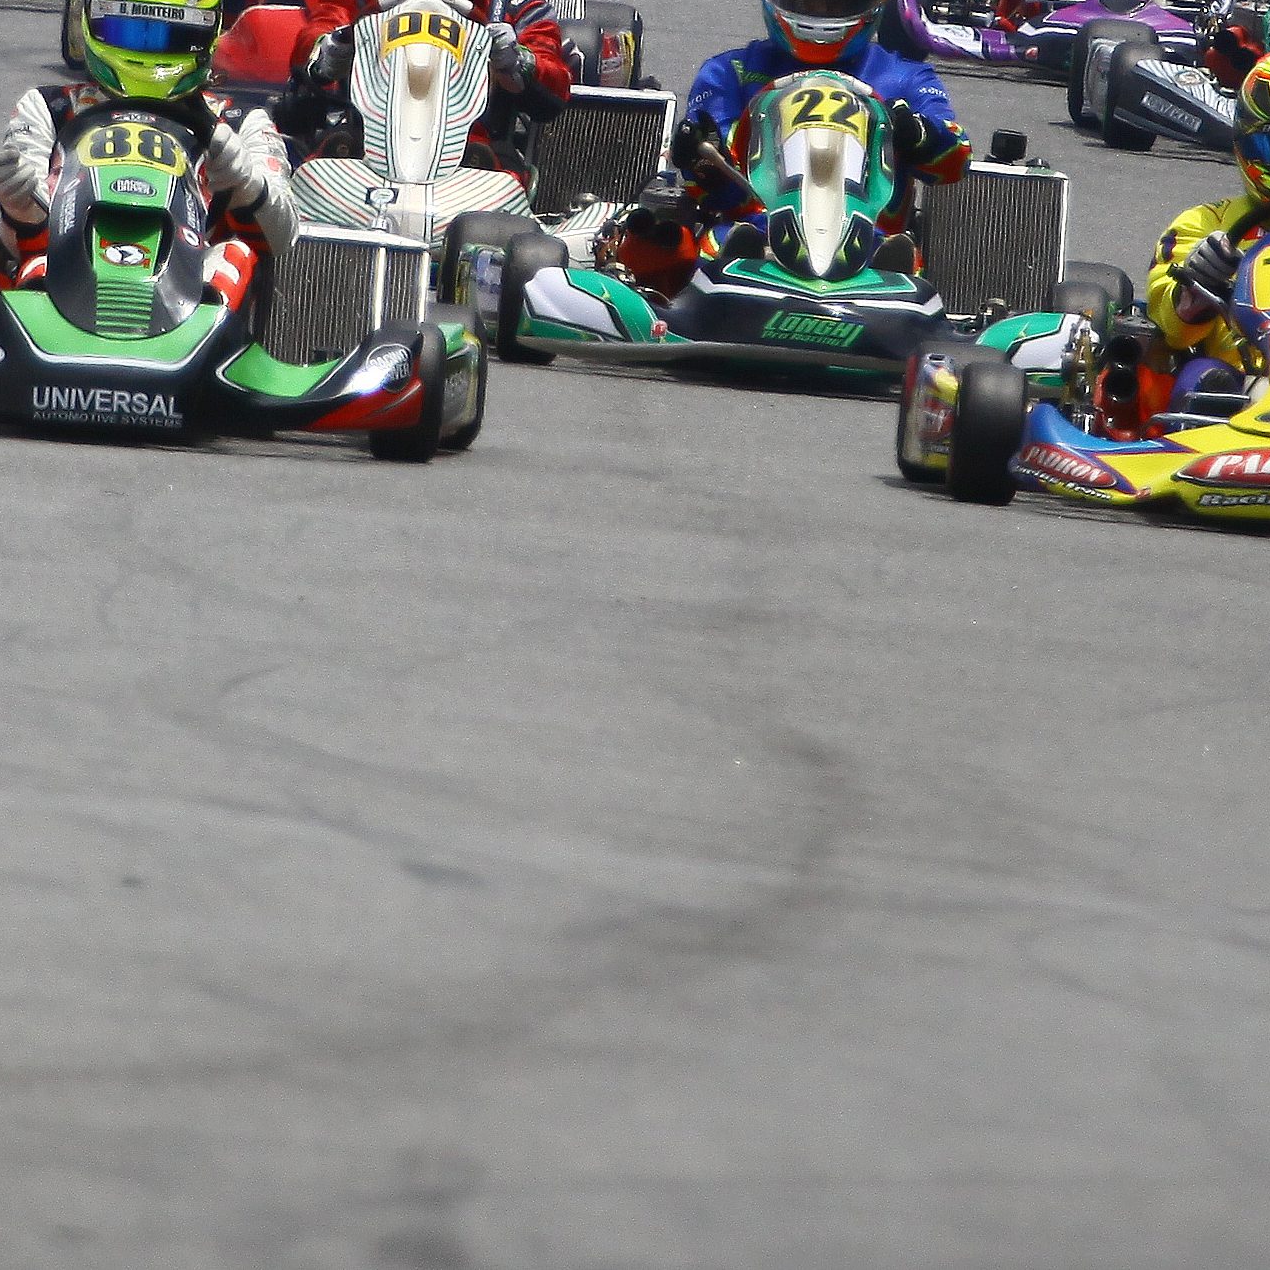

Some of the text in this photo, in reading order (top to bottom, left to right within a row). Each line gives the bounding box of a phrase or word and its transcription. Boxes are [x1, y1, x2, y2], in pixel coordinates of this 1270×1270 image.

[131, 3, 185, 21] MONTEIRO
[790, 88, 861, 135] 22
[90, 127, 178, 168] 88
[32, 385, 184, 419] UNIVERSAL
[32, 410, 184, 429] AUTOMOTIVE SYSTEMS
[1024, 445, 1103, 483] PADRON
